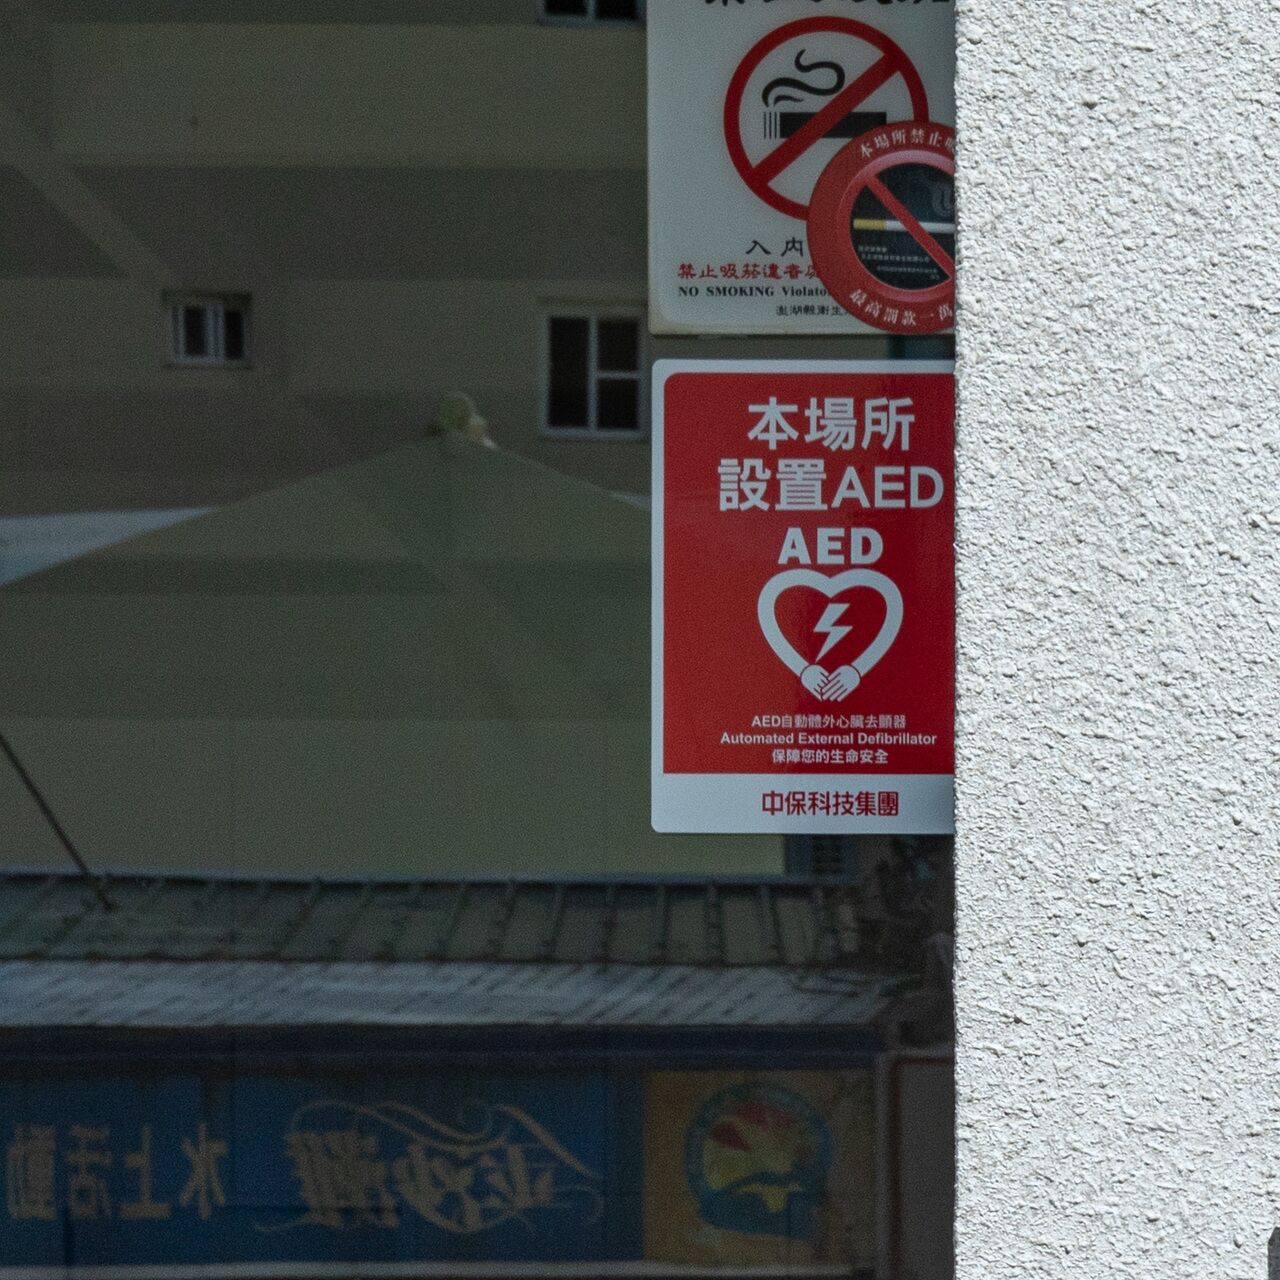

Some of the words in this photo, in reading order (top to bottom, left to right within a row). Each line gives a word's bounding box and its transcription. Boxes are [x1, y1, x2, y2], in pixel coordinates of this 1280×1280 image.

[745, 237, 804, 257] 入內
[678, 286, 699, 297] NO
[706, 285, 774, 297] SMOKING
[781, 285, 829, 298] Violato
[747, 397, 914, 451] 本場所
[717, 458, 944, 511] 設置AED
[777, 527, 884, 565] AED
[720, 732, 794, 745] Automated
[798, 732, 854, 745] External
[858, 732, 938, 745] Defibrillator
[772, 749, 889, 764] 保障您的生命安全
[761, 791, 899, 817] 中保科技集團
